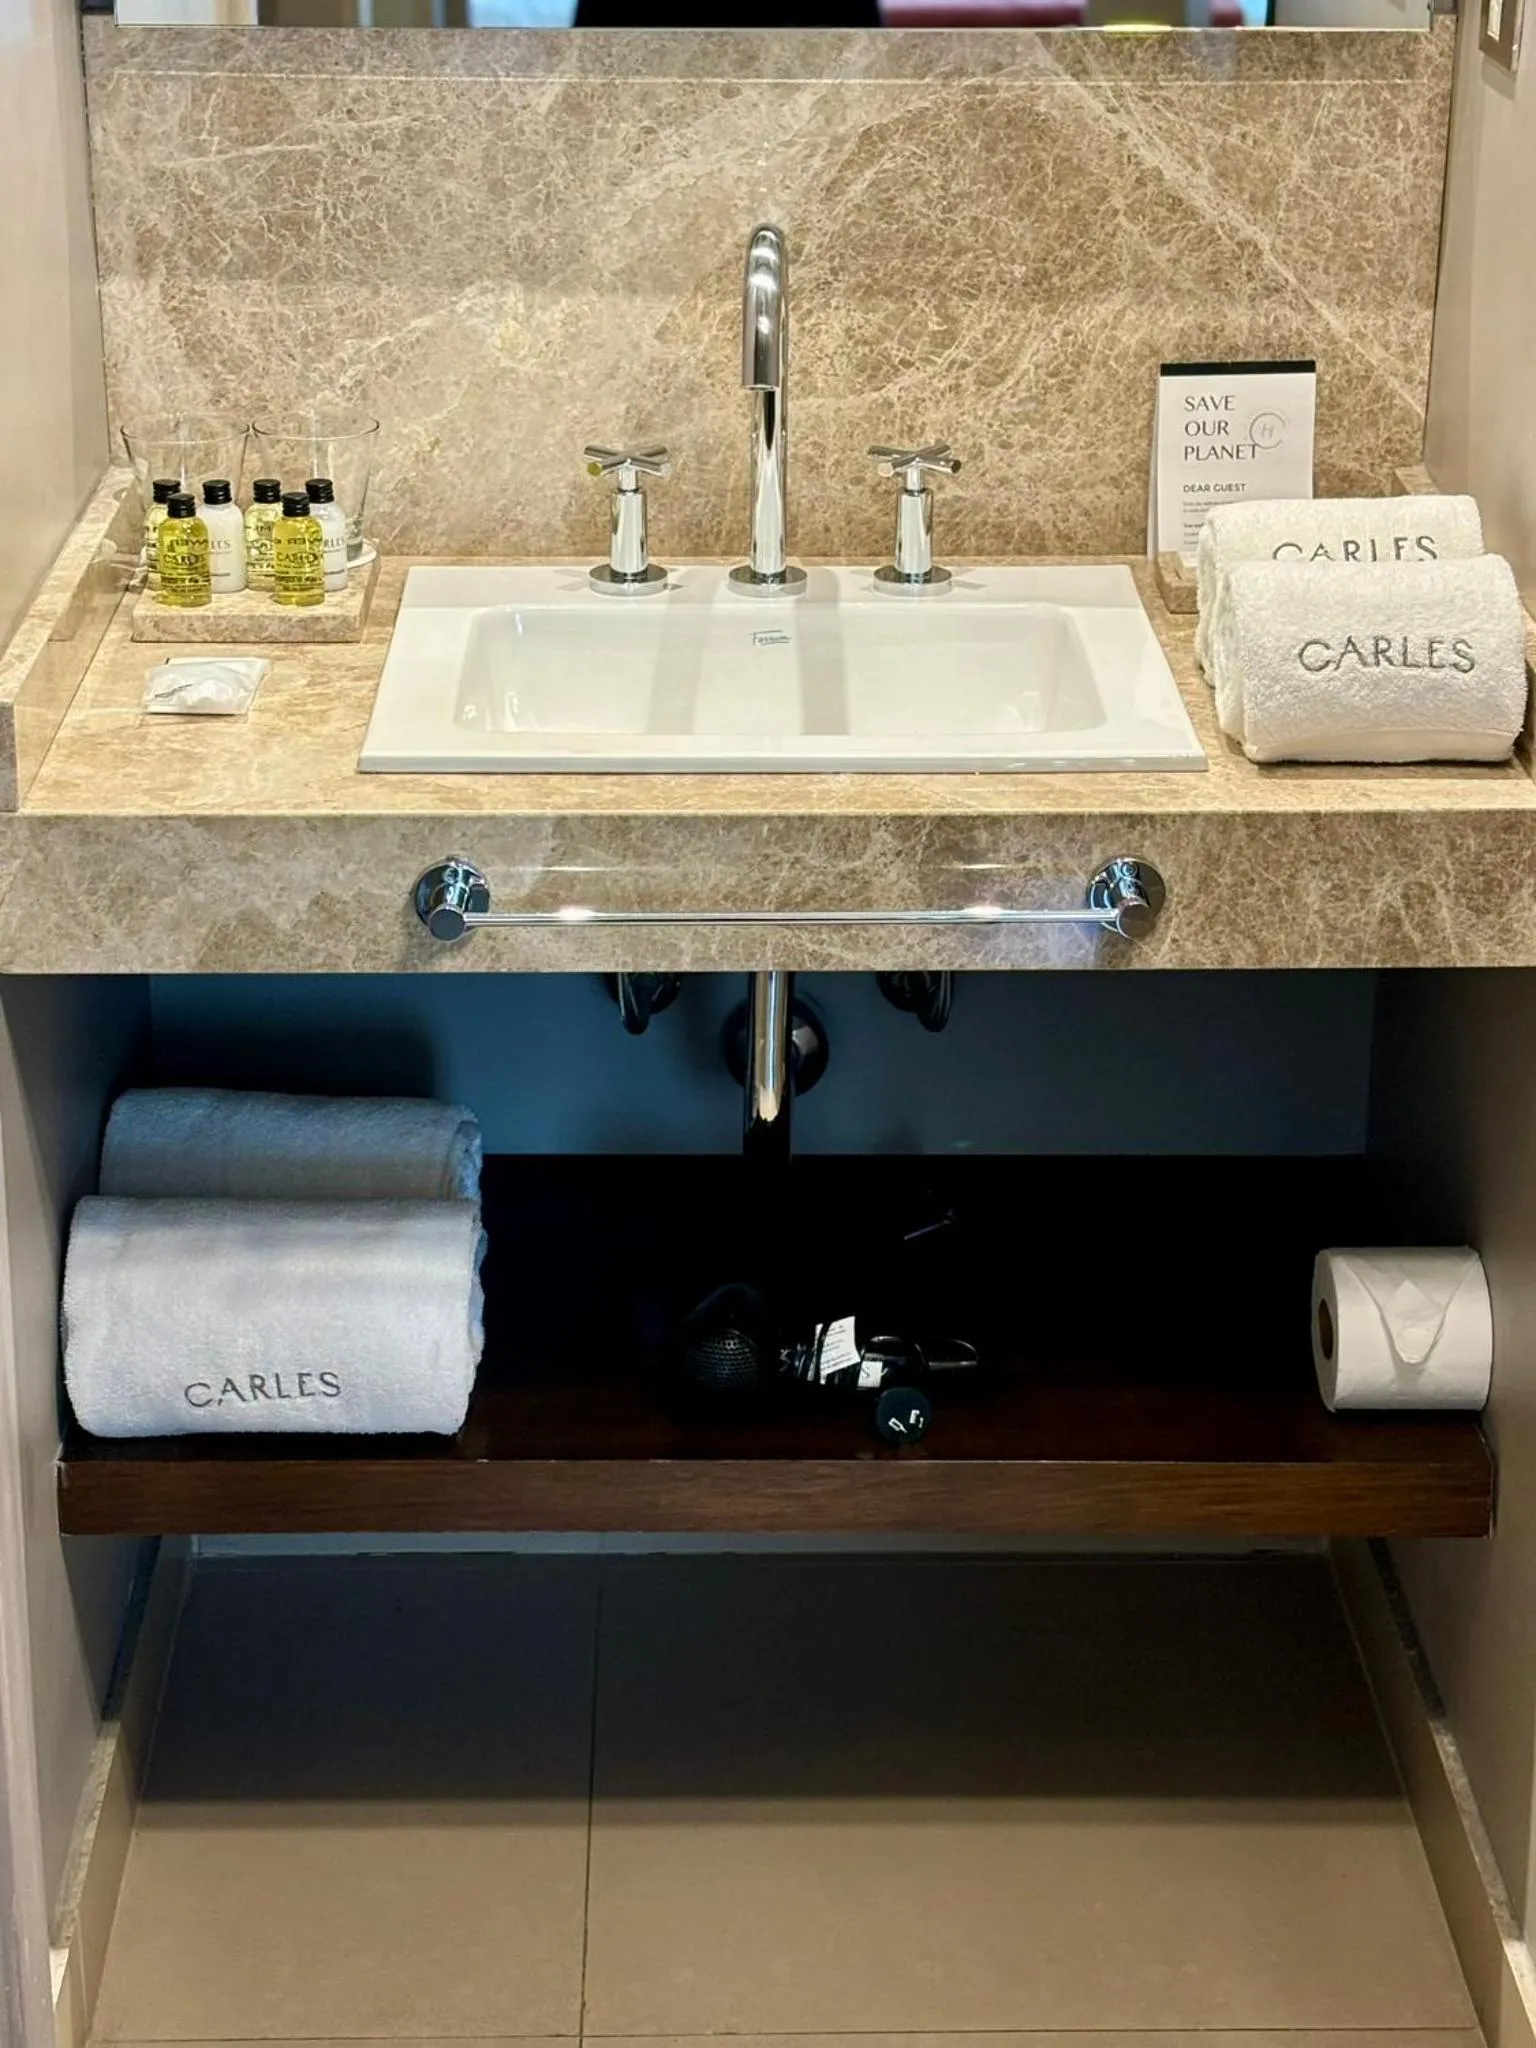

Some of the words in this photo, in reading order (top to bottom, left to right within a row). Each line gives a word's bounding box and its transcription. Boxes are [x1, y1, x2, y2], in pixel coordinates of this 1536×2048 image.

[1184, 395, 1236, 412] SAVE
[1184, 419, 1230, 437] OUR
[1184, 443, 1257, 461] PLANET
[1183, 484, 1211, 493] DEAR
[1213, 483, 1247, 493] GUEST
[1298, 635, 1476, 674] CARLES
[184, 1371, 342, 1408] CARLES
